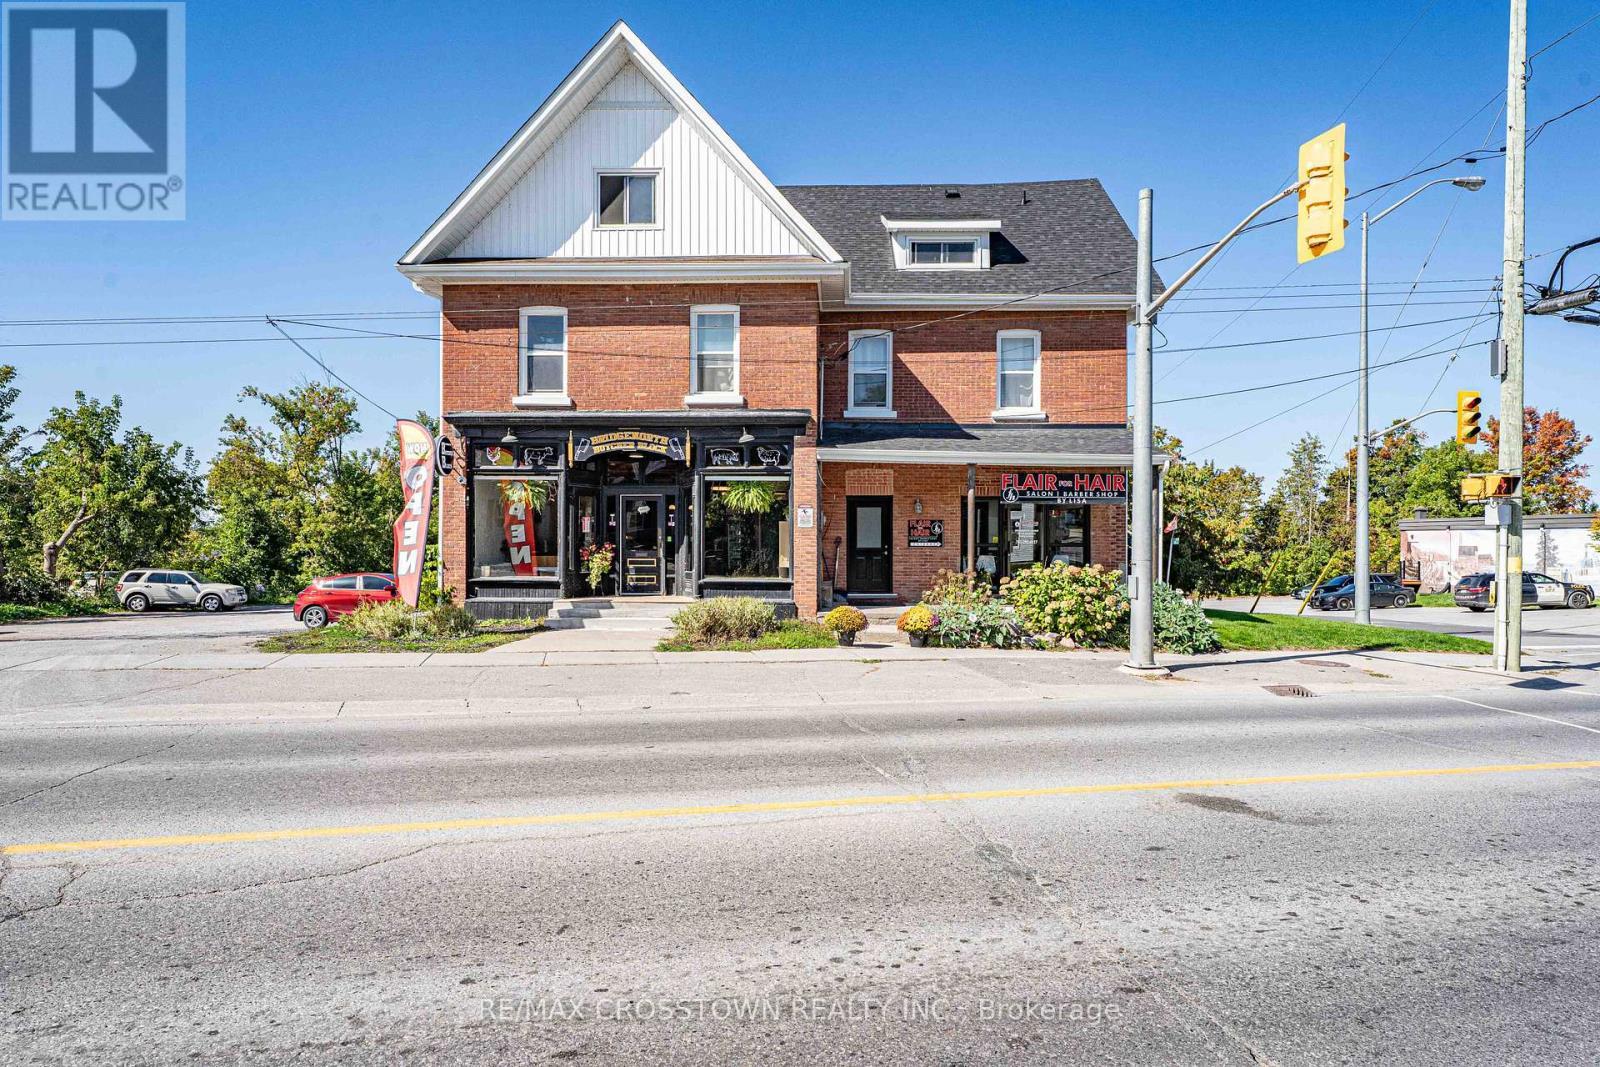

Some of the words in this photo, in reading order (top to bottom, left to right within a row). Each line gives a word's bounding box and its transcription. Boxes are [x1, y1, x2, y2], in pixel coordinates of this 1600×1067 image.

[592, 441, 635, 454] BUTCHER
[637, 441, 668, 454] BLOCK
[1001, 474, 1058, 491] FLAIR
[1074, 474, 1126, 492] HAIR
